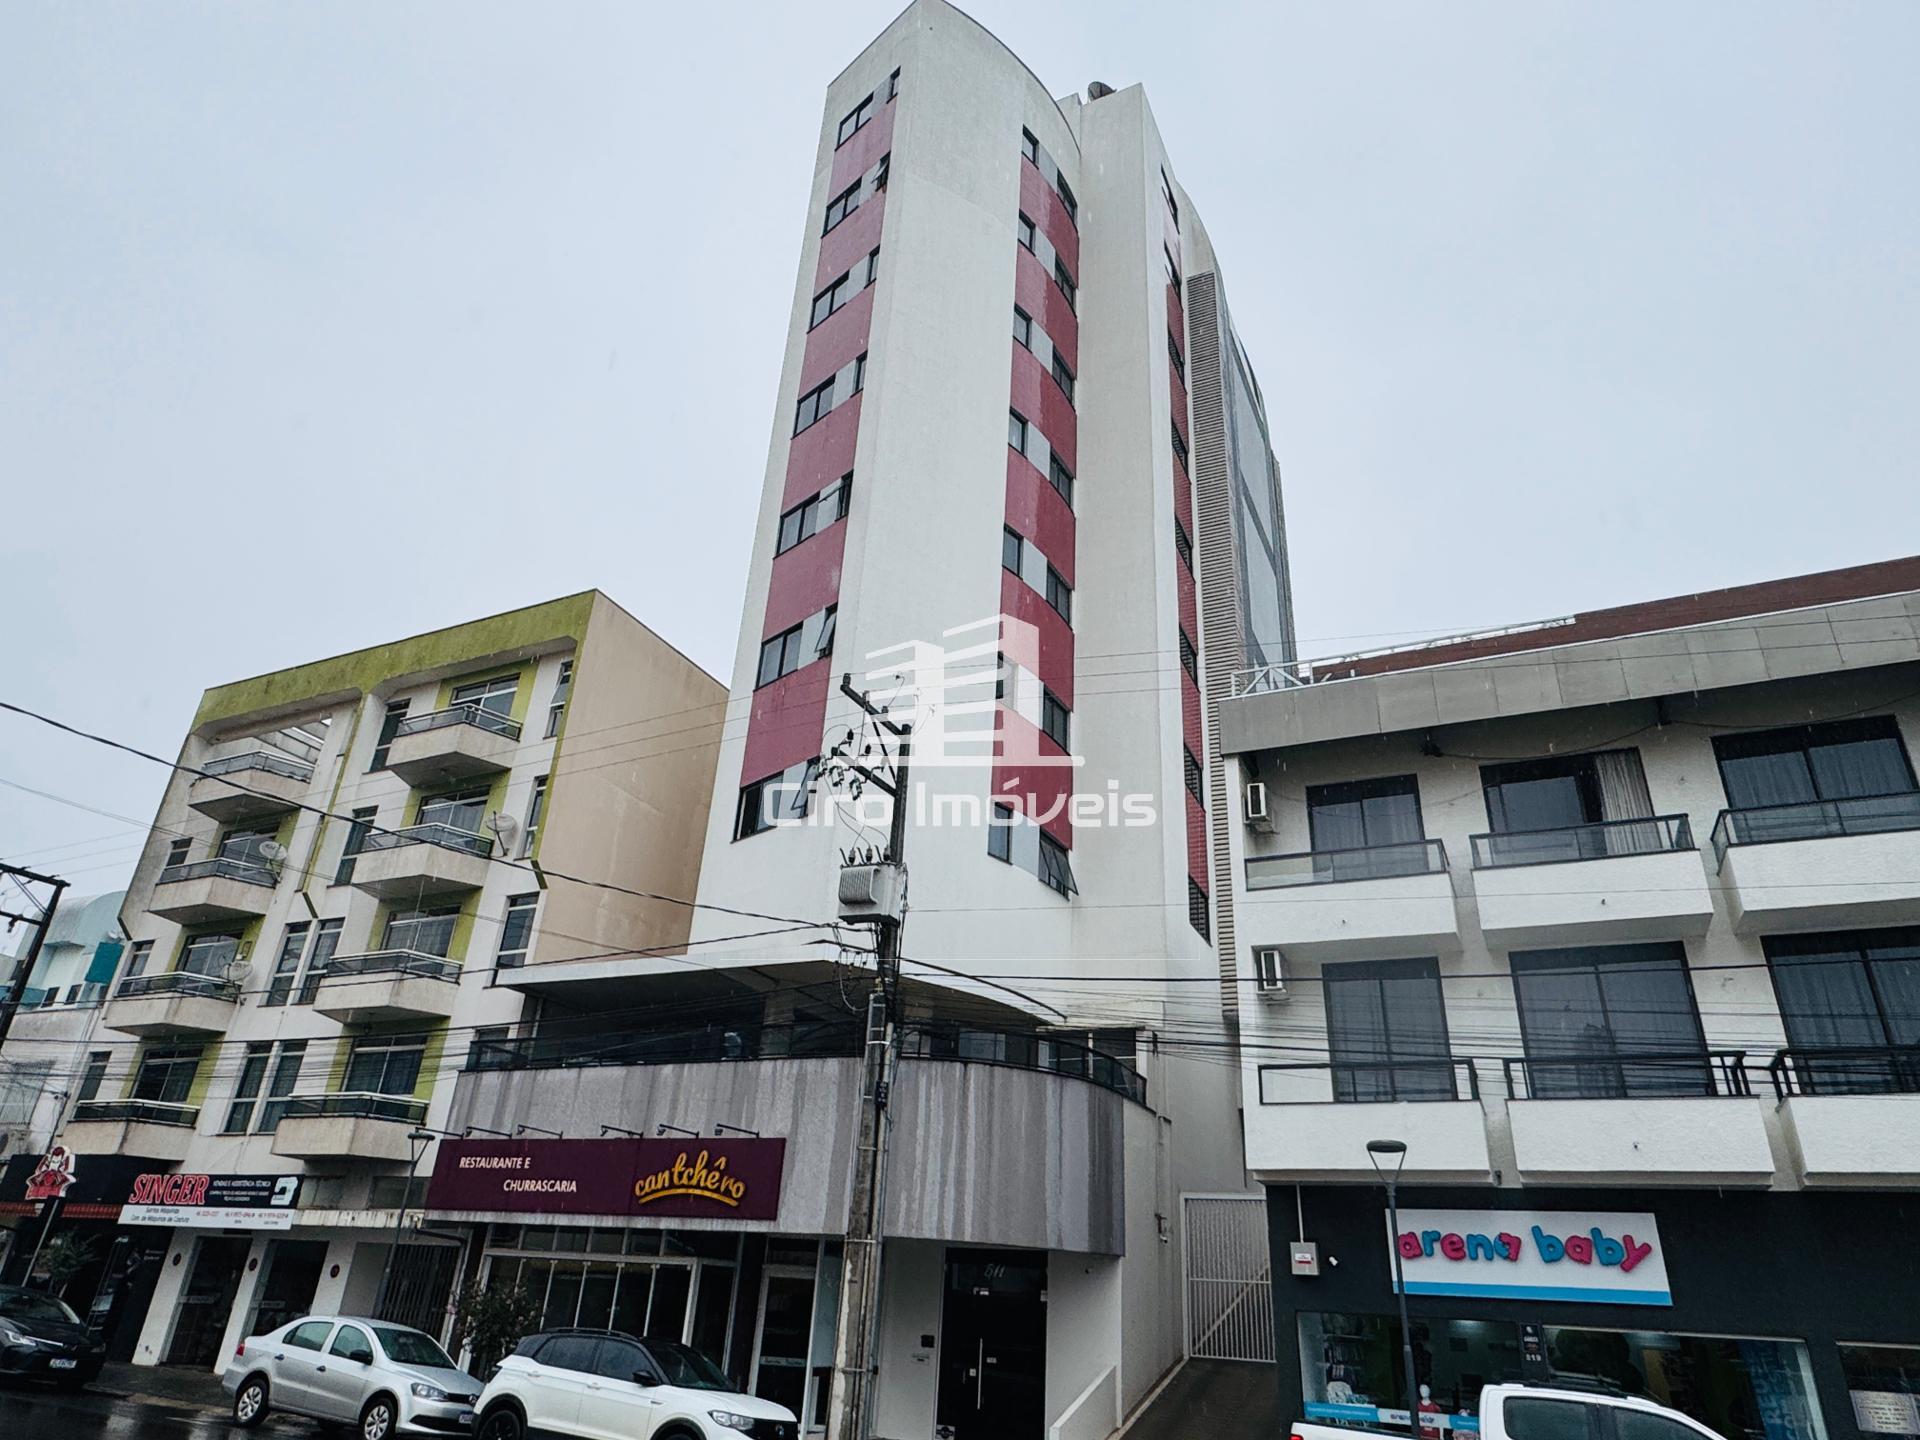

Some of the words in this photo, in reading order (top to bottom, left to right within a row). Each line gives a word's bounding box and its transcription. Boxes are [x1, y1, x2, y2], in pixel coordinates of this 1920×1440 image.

[459, 1155, 523, 1170] RESTAURANTE
[524, 1157, 531, 1170] E
[128, 1174, 210, 1205] SINGER
[503, 1178, 577, 1194] CHURRASCARIA
[1397, 1231, 1522, 1262] arena
[1531, 1226, 1652, 1273] baby
